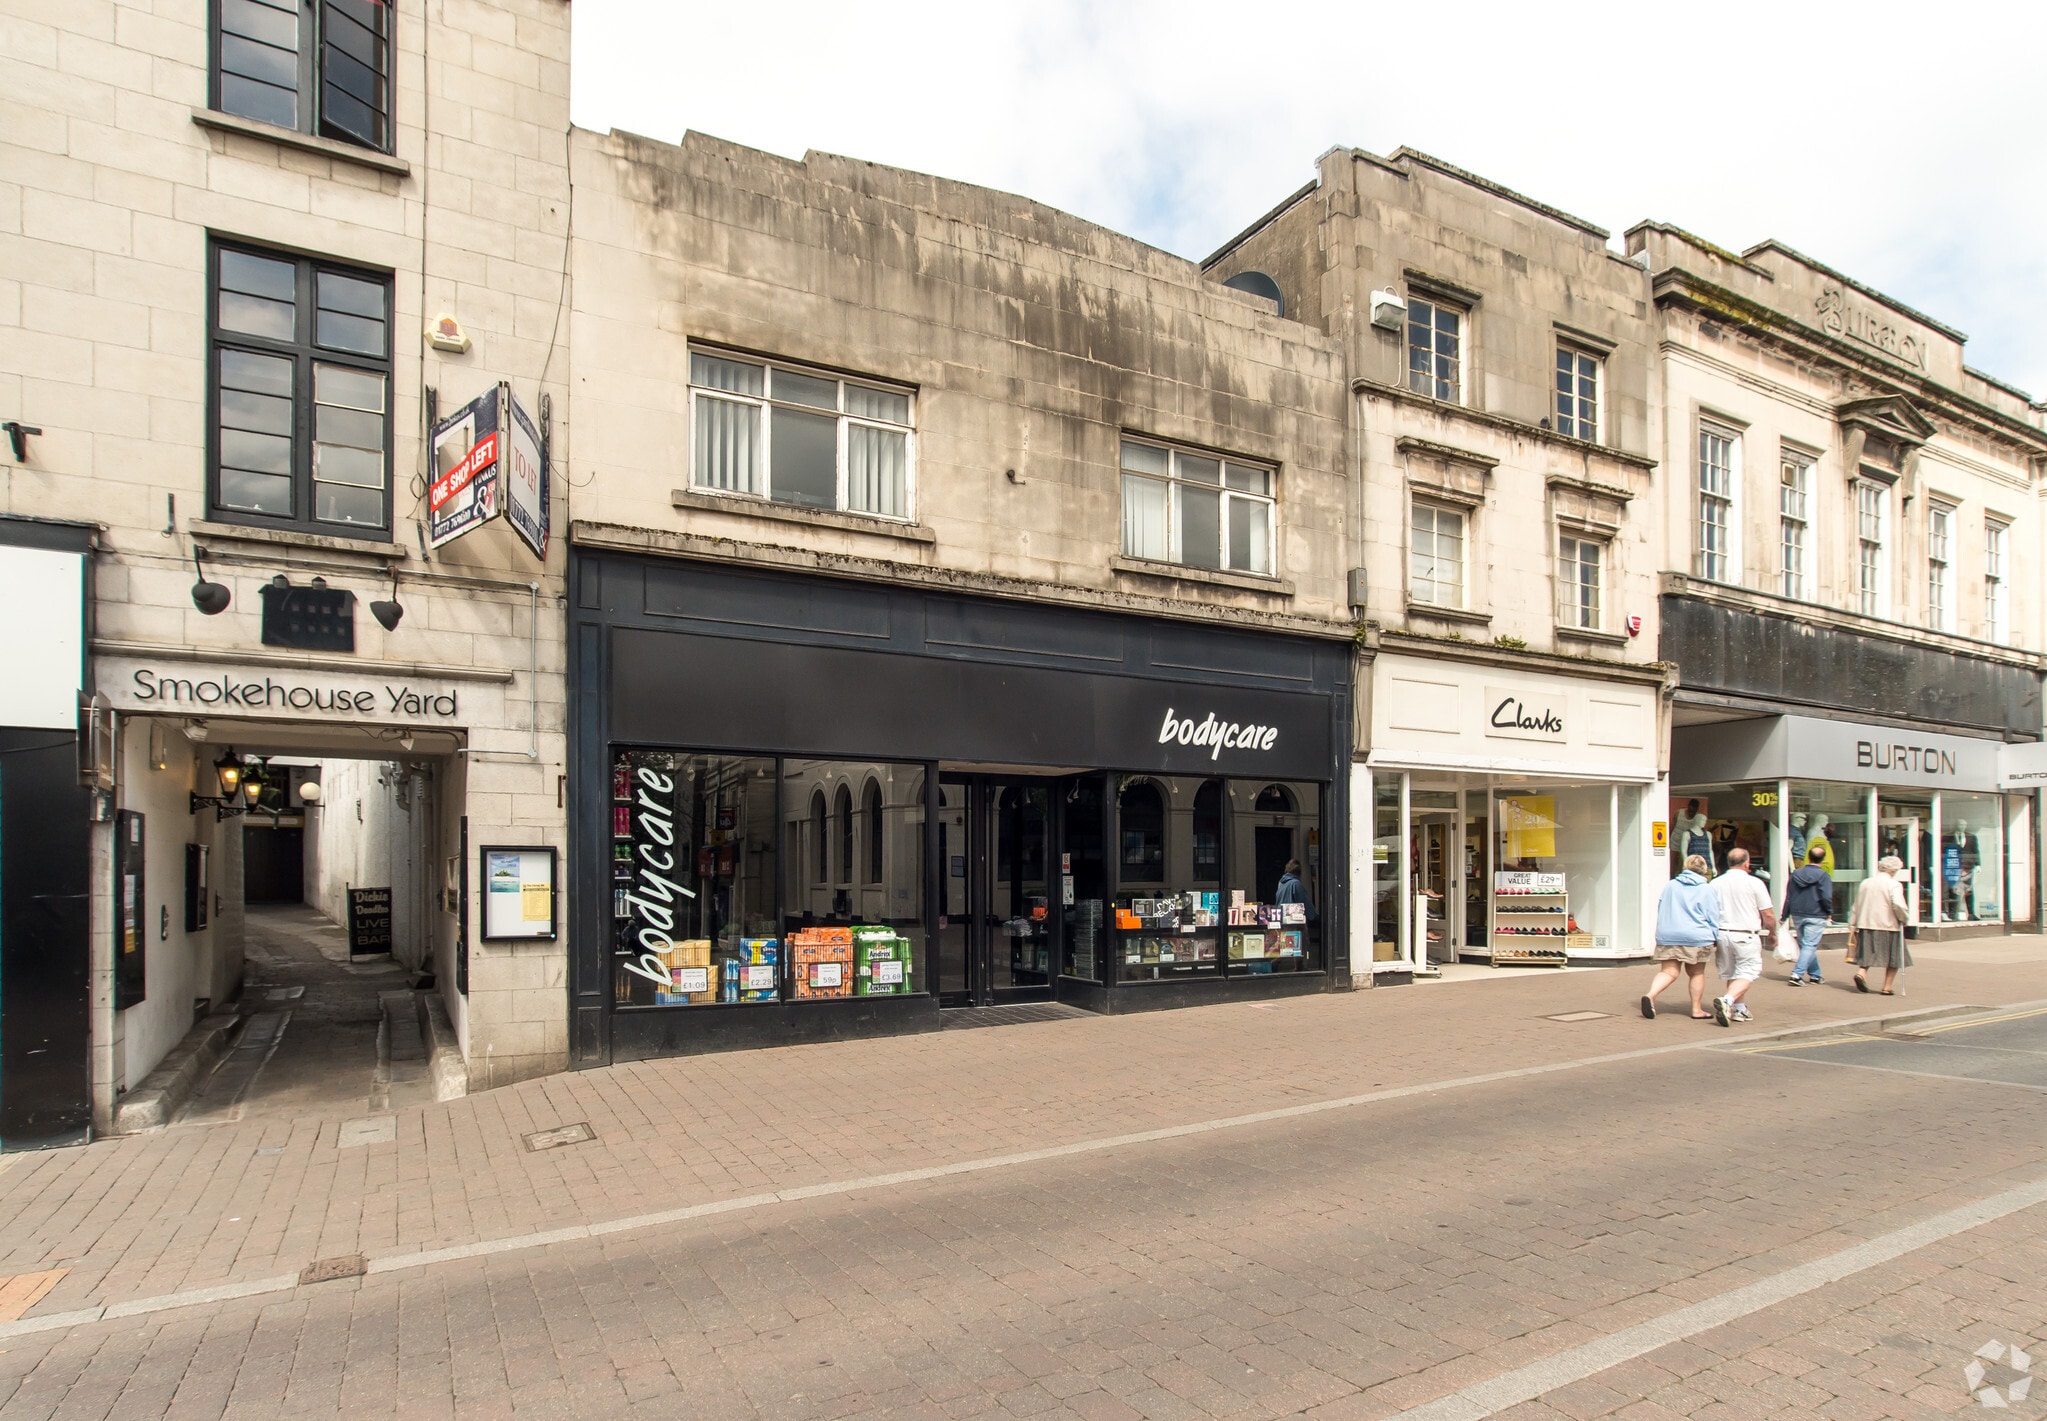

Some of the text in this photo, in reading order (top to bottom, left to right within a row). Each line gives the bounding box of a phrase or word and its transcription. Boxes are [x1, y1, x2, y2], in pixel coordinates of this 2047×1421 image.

[432, 481, 449, 506] ONE
[450, 460, 470, 492] SHOP
[471, 440, 494, 472] LEFT
[514, 447, 537, 496] TO LET
[133, 668, 458, 717] Smokehouse Yard
[1490, 696, 1563, 734] Clarks
[1158, 706, 1279, 761] bodycare
[1856, 739, 1957, 776] BURTON
[622, 766, 696, 988] bodycare
[354, 890, 389, 902] Dickie
[356, 918, 390, 929] LIVE
[357, 935, 390, 946] BAR
[868, 950, 891, 958] Andrex
[750, 978, 772, 987] £2.29
[823, 976, 837, 985] 59p
[882, 973, 902, 981] £3.69
[683, 981, 706, 989] £1.09
[868, 984, 891, 992] Andrex
